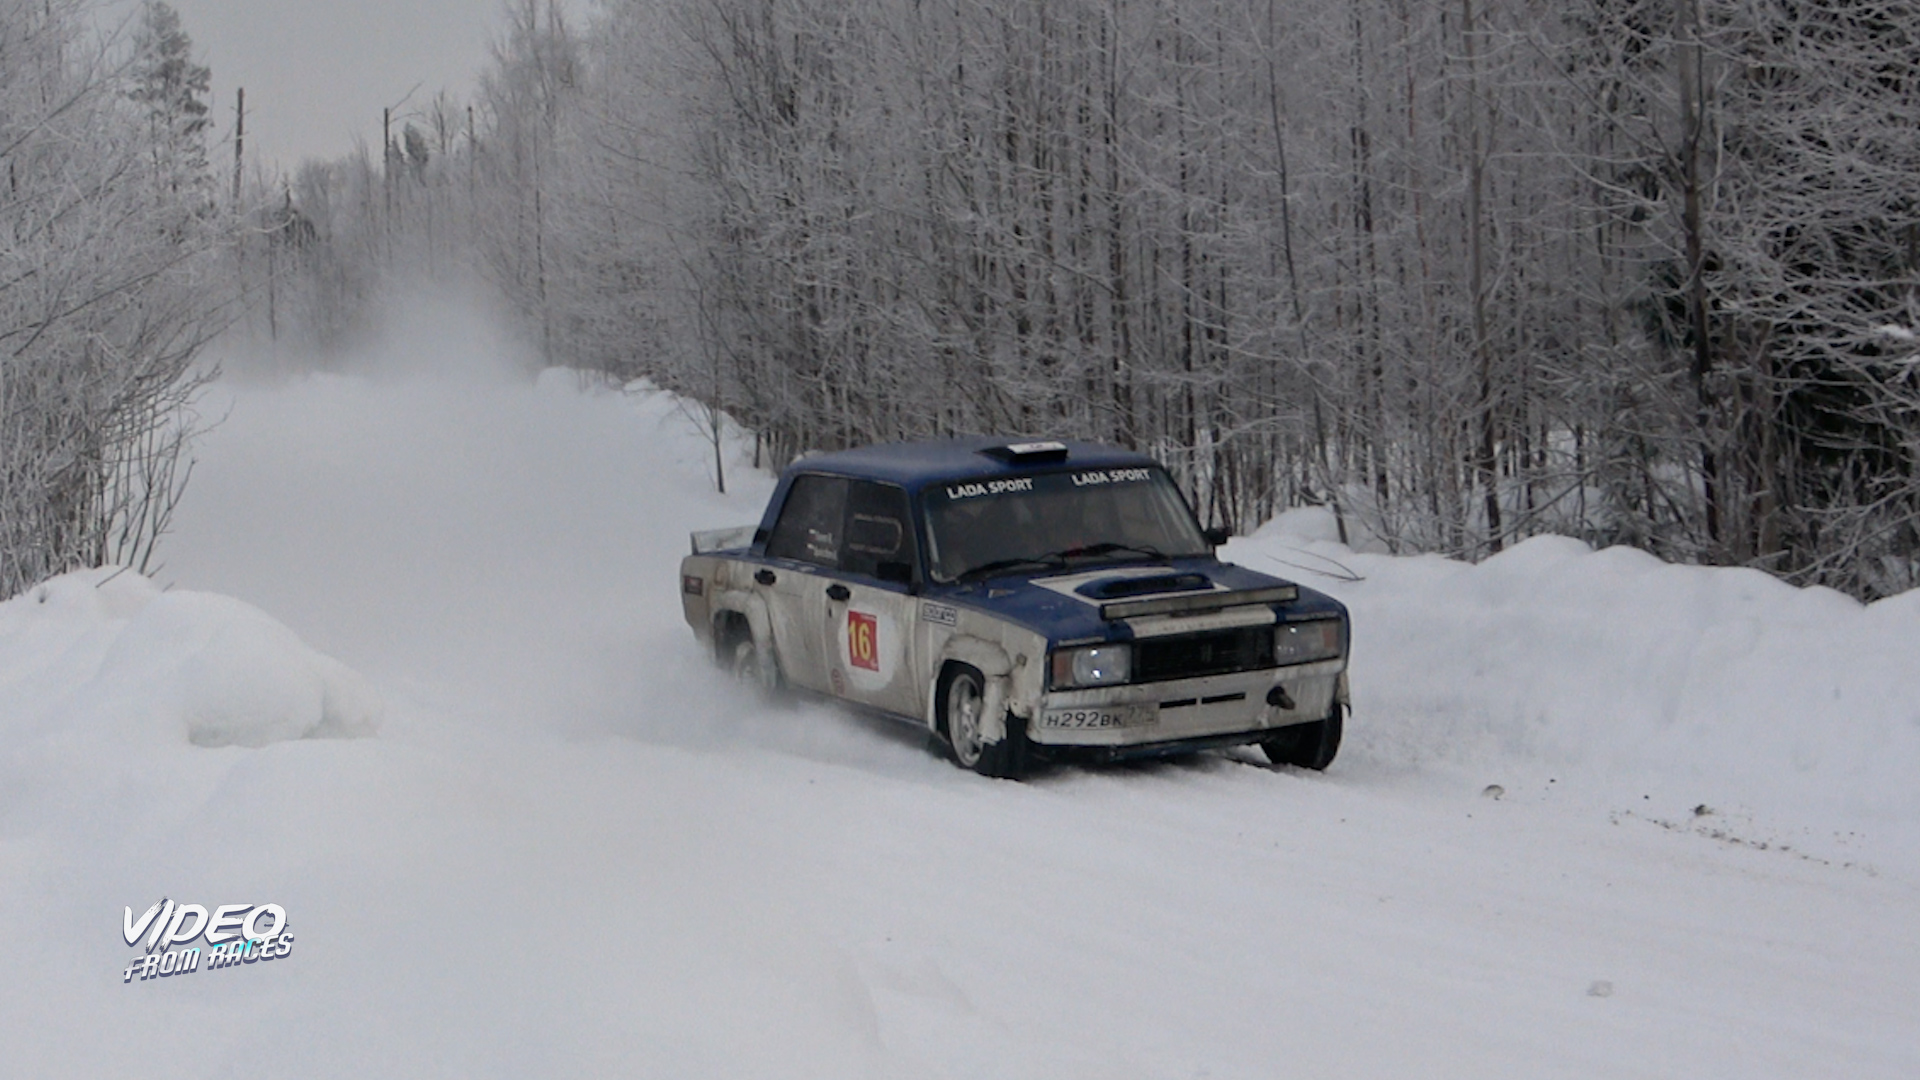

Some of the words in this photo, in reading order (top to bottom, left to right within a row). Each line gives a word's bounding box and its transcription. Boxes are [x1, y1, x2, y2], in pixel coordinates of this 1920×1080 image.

[946, 482, 987, 499] LADA
[987, 477, 1033, 494] SPORT
[1072, 470, 1109, 487] LADA
[1110, 467, 1151, 483] SPORT
[848, 620, 871, 661] 16
